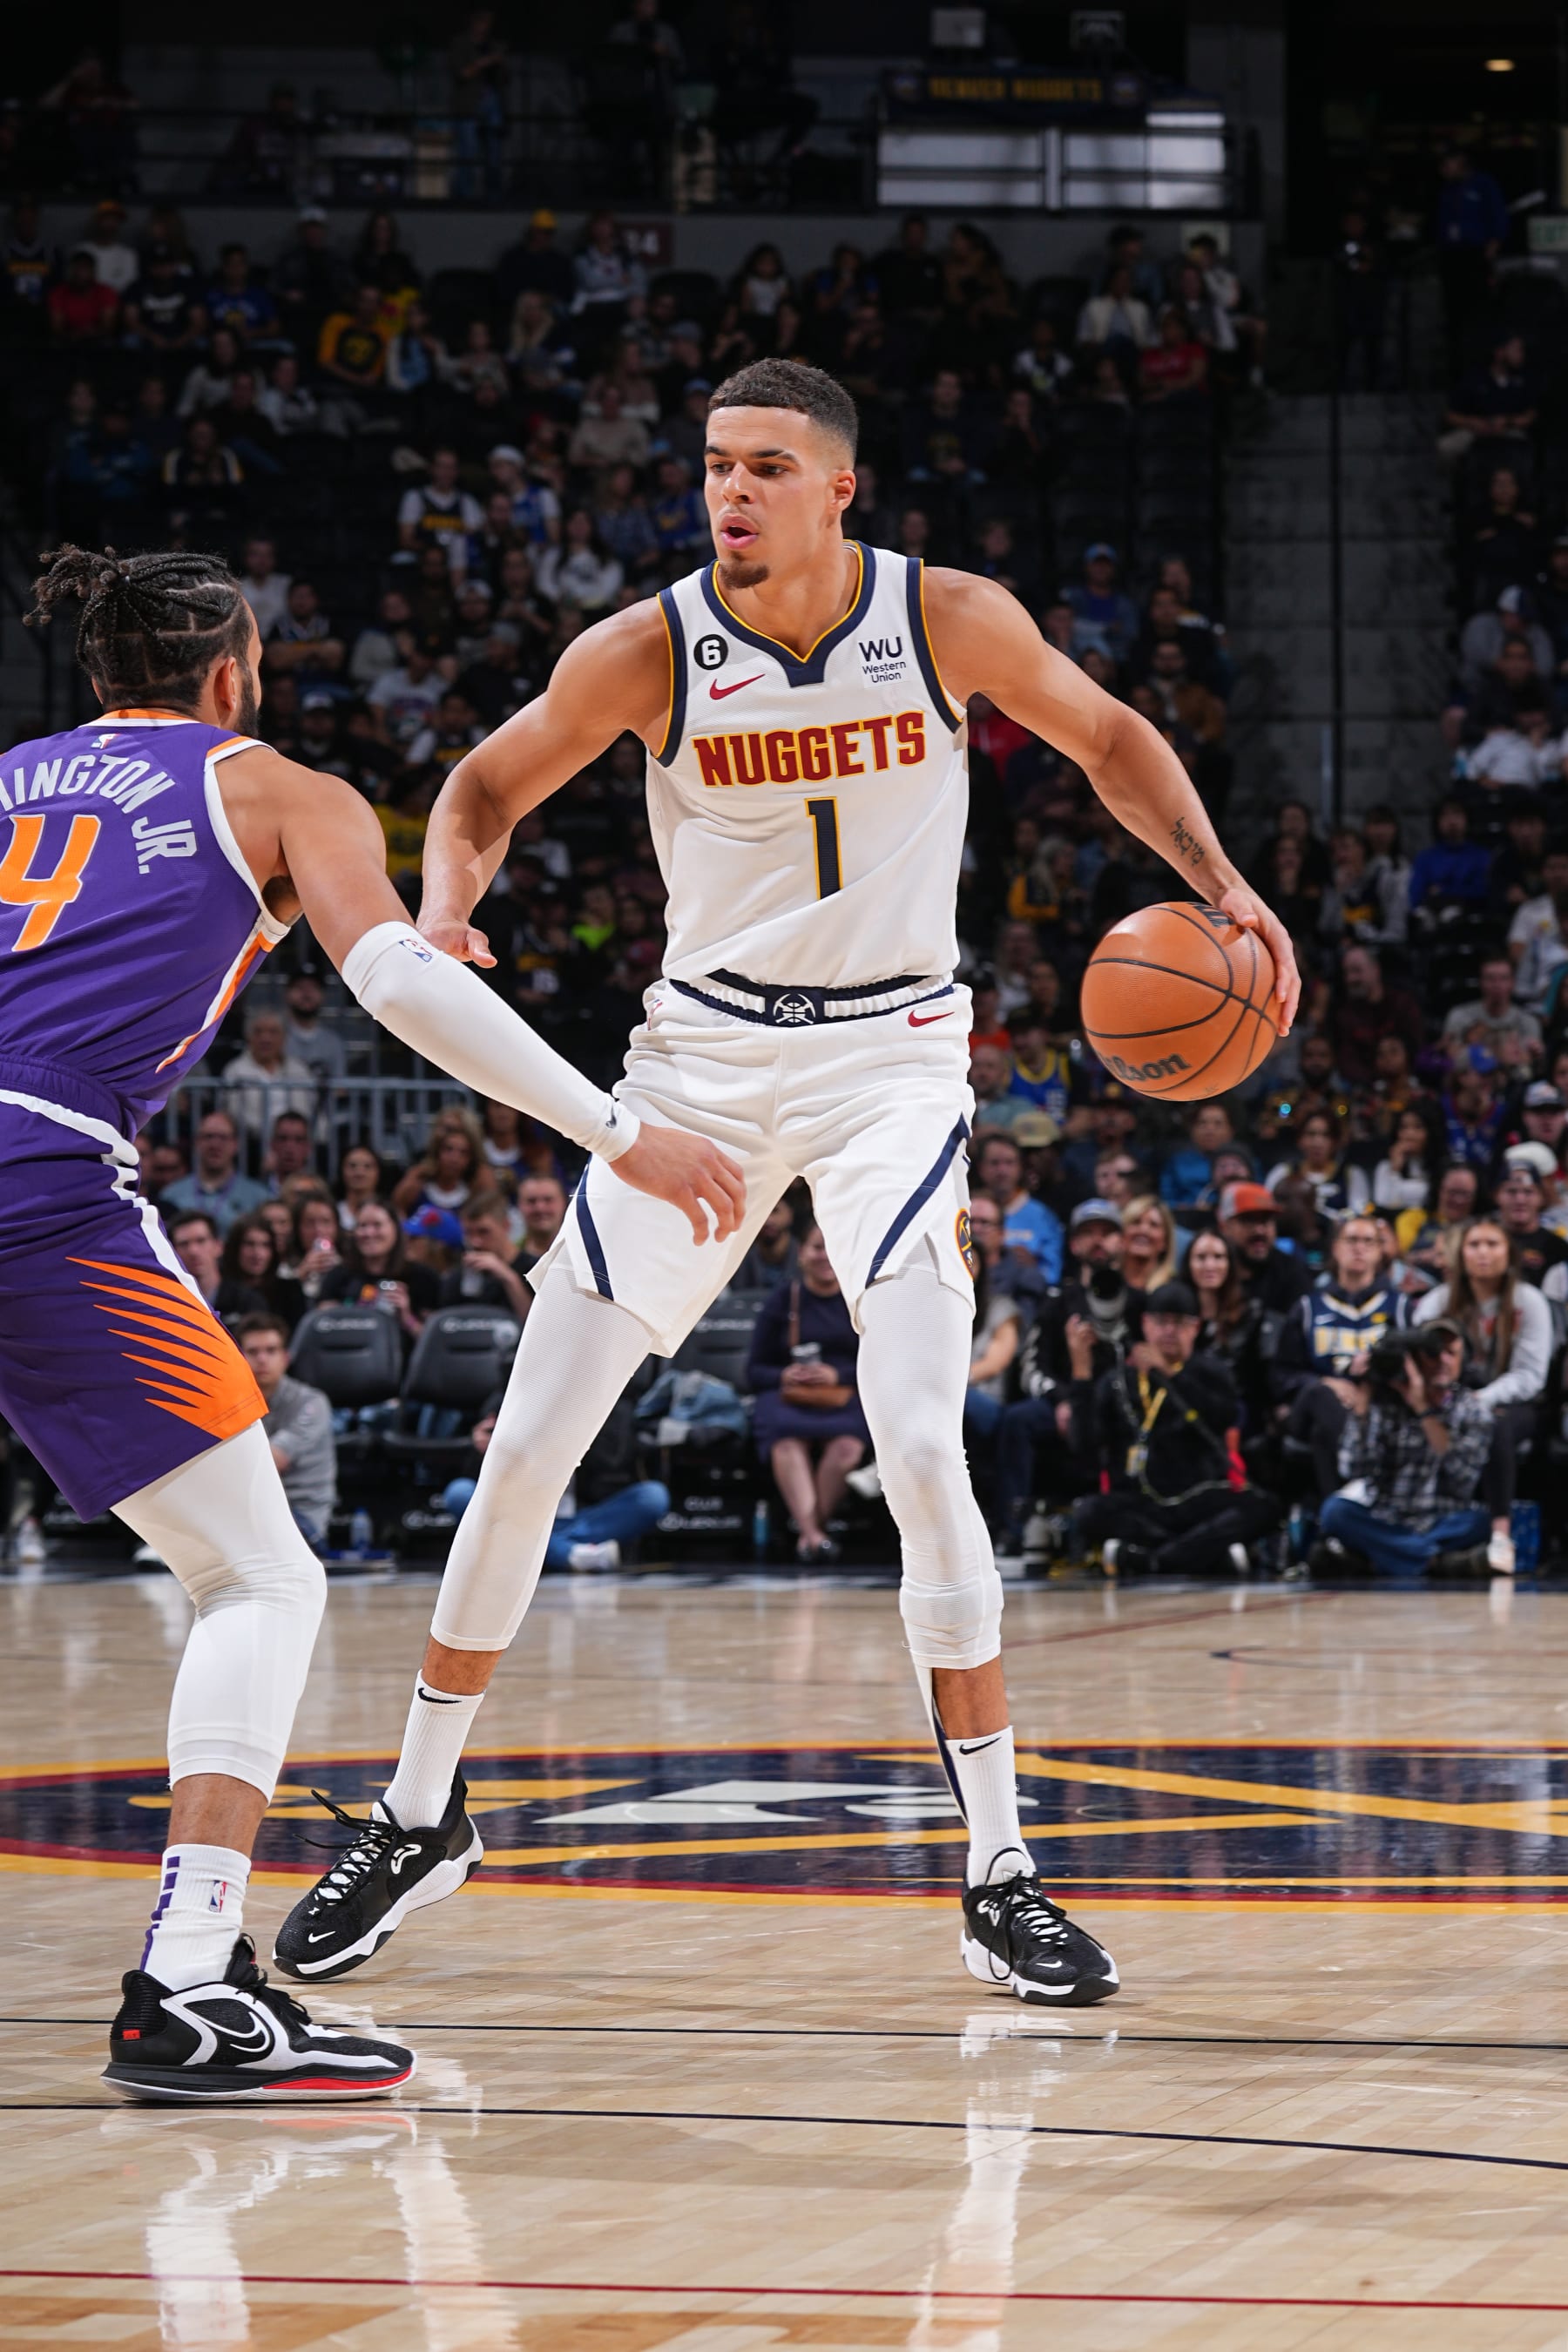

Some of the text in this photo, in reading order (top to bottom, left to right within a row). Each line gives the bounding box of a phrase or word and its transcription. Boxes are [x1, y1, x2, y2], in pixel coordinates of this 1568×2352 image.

[701, 639, 722, 666] 6
[858, 636, 902, 662] WU
[862, 661, 906, 674] Western
[871, 672, 901, 683] Union
[691, 710, 926, 788] NUGGETS
[131, 816, 198, 875] JR.
[804, 796, 843, 901] 1
[0, 814, 102, 952] 4
